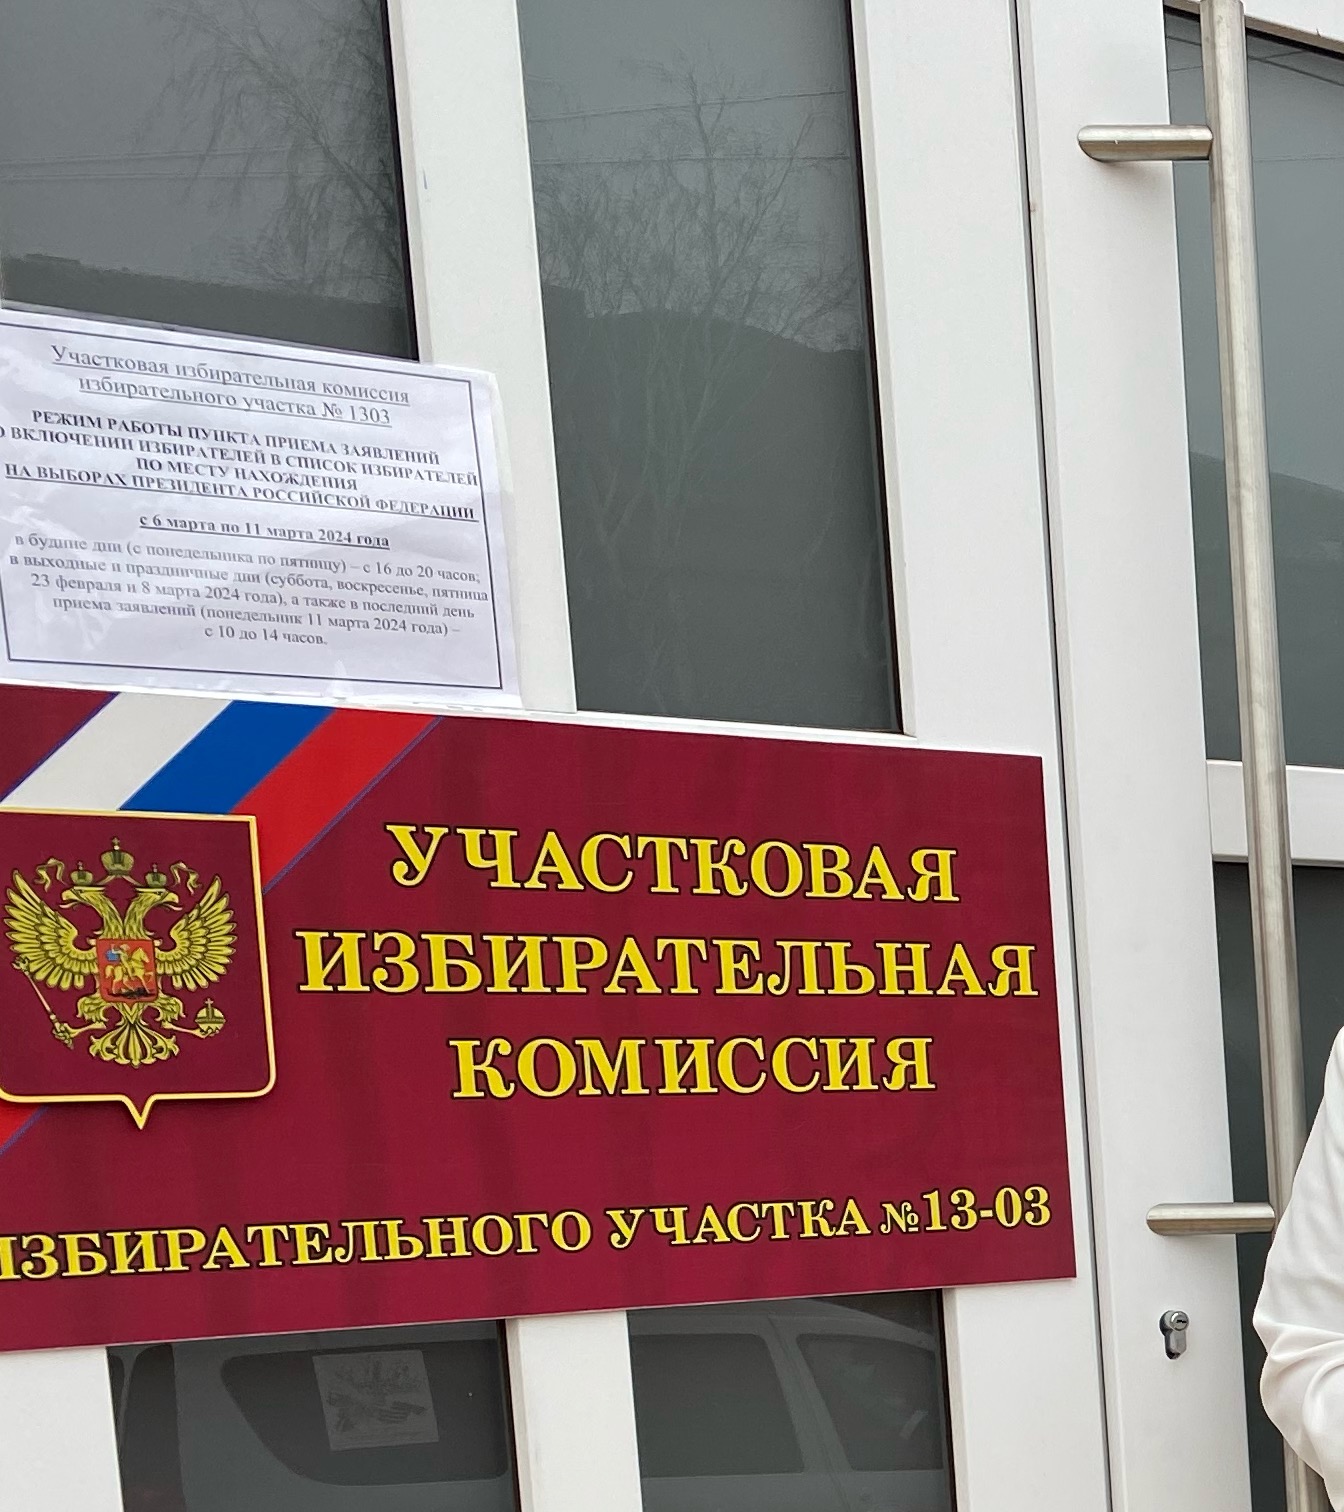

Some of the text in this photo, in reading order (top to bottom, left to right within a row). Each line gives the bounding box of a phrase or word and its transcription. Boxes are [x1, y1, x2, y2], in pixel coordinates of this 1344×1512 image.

[51, 345, 410, 404] Участковая избирательная комиссия
[79, 377, 390, 425] избирательного участка № 1303
[11, 426, 134, 451] ВКЛЮЧЕНИИ
[139, 439, 267, 465] ИЗБИРАТЕЛЕЙ
[271, 453, 281, 466] В
[286, 456, 358, 474] СПИСОК
[361, 463, 478, 486] ИЗБИРАТЕЛЕЙ
[32, 410, 440, 465] РЕЖИМ РАБОТЫ ПУНКТА ПРИЕМА ЗАЯВЛЕНИЙ
[5, 463, 474, 520] НА ВЫБОРАХ ПРЕЗИДЕНТА РОССИЙСКОЙ ФЕДЕРАЦИИ
[136, 457, 358, 491] ПО МЕСТУ НАХОЖДЕНИЯ
[15, 534, 24, 545] в
[28, 533, 88, 551] будние
[92, 541, 123, 553] дни
[146, 545, 254, 564] понедельника
[257, 553, 276, 566] по
[280, 556, 347, 574] пятницу)
[363, 564, 371, 573] с
[376, 562, 392, 575] 16
[395, 566, 413, 578] до
[417, 565, 433, 579] 20
[139, 514, 390, 548] с 6 марта по 11 марта 2024 года
[9, 554, 489, 602] в выходные и праздничные дни (суббота, воскресенье, пятница
[31, 573, 475, 620] 23 февраля и 8 марта 2024 года), а также в последний день
[53, 597, 112, 613] приема
[116, 602, 196, 617] заявлений
[200, 609, 303, 626] (понедельник
[308, 613, 322, 626] 11
[328, 616, 370, 632] марта
[373, 617, 407, 633] 2024
[411, 623, 449, 637] года)
[204, 627, 213, 637] с
[218, 625, 235, 639] 10
[239, 630, 257, 641] до
[263, 628, 279, 641] 14
[385, 822, 959, 904] УЧАСТКОВАЯ
[296, 930, 1039, 999] ИЗБИРАТЕЛЬНАЯ
[450, 1035, 936, 1100] КОМИССИЯ
[608, 1198, 872, 1250] УЧАСТКА
